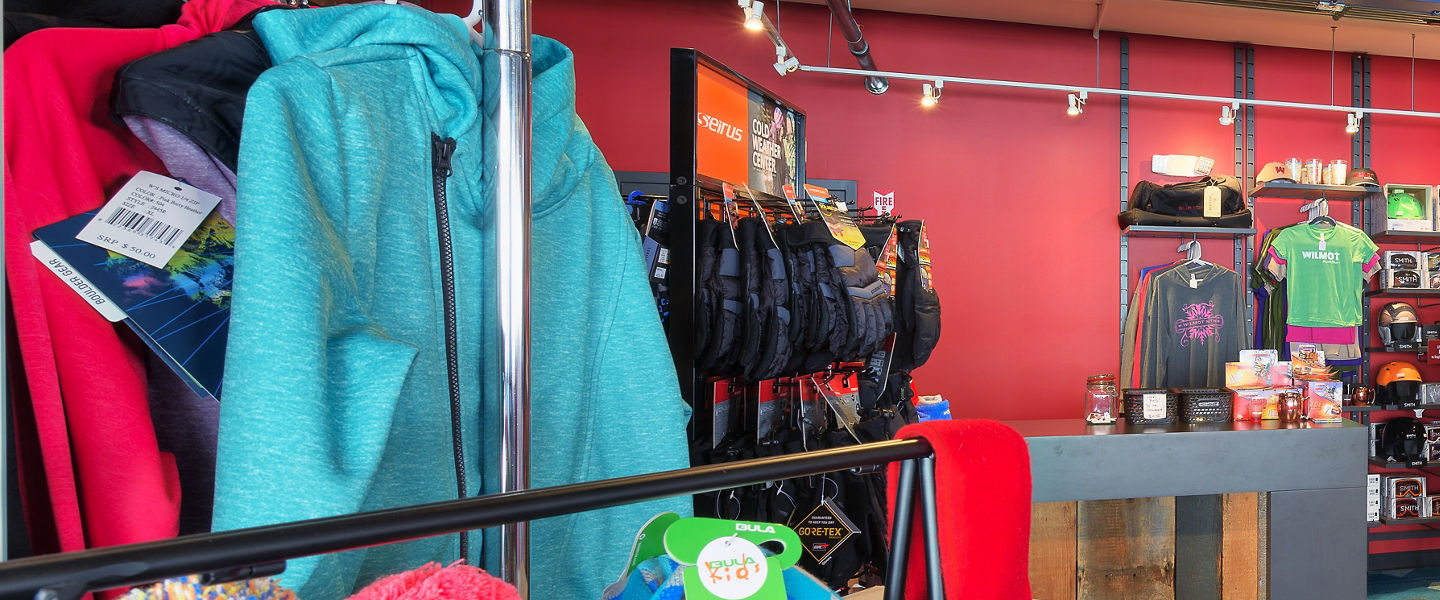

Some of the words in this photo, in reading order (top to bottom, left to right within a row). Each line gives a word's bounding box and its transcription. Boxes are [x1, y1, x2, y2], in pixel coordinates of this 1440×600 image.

[752, 118, 770, 139] COLD
[752, 133, 782, 160] WEATHER
[874, 196, 893, 206] FIRE
[97, 234, 119, 245] SRP
[129, 246, 156, 259] 50.00
[1302, 250, 1340, 260] WILMOT
[48, 258, 73, 277] GEAR
[69, 275, 106, 305] BOULDER
[735, 522, 776, 534] BULA
[798, 527, 842, 536] GORE-TEX
